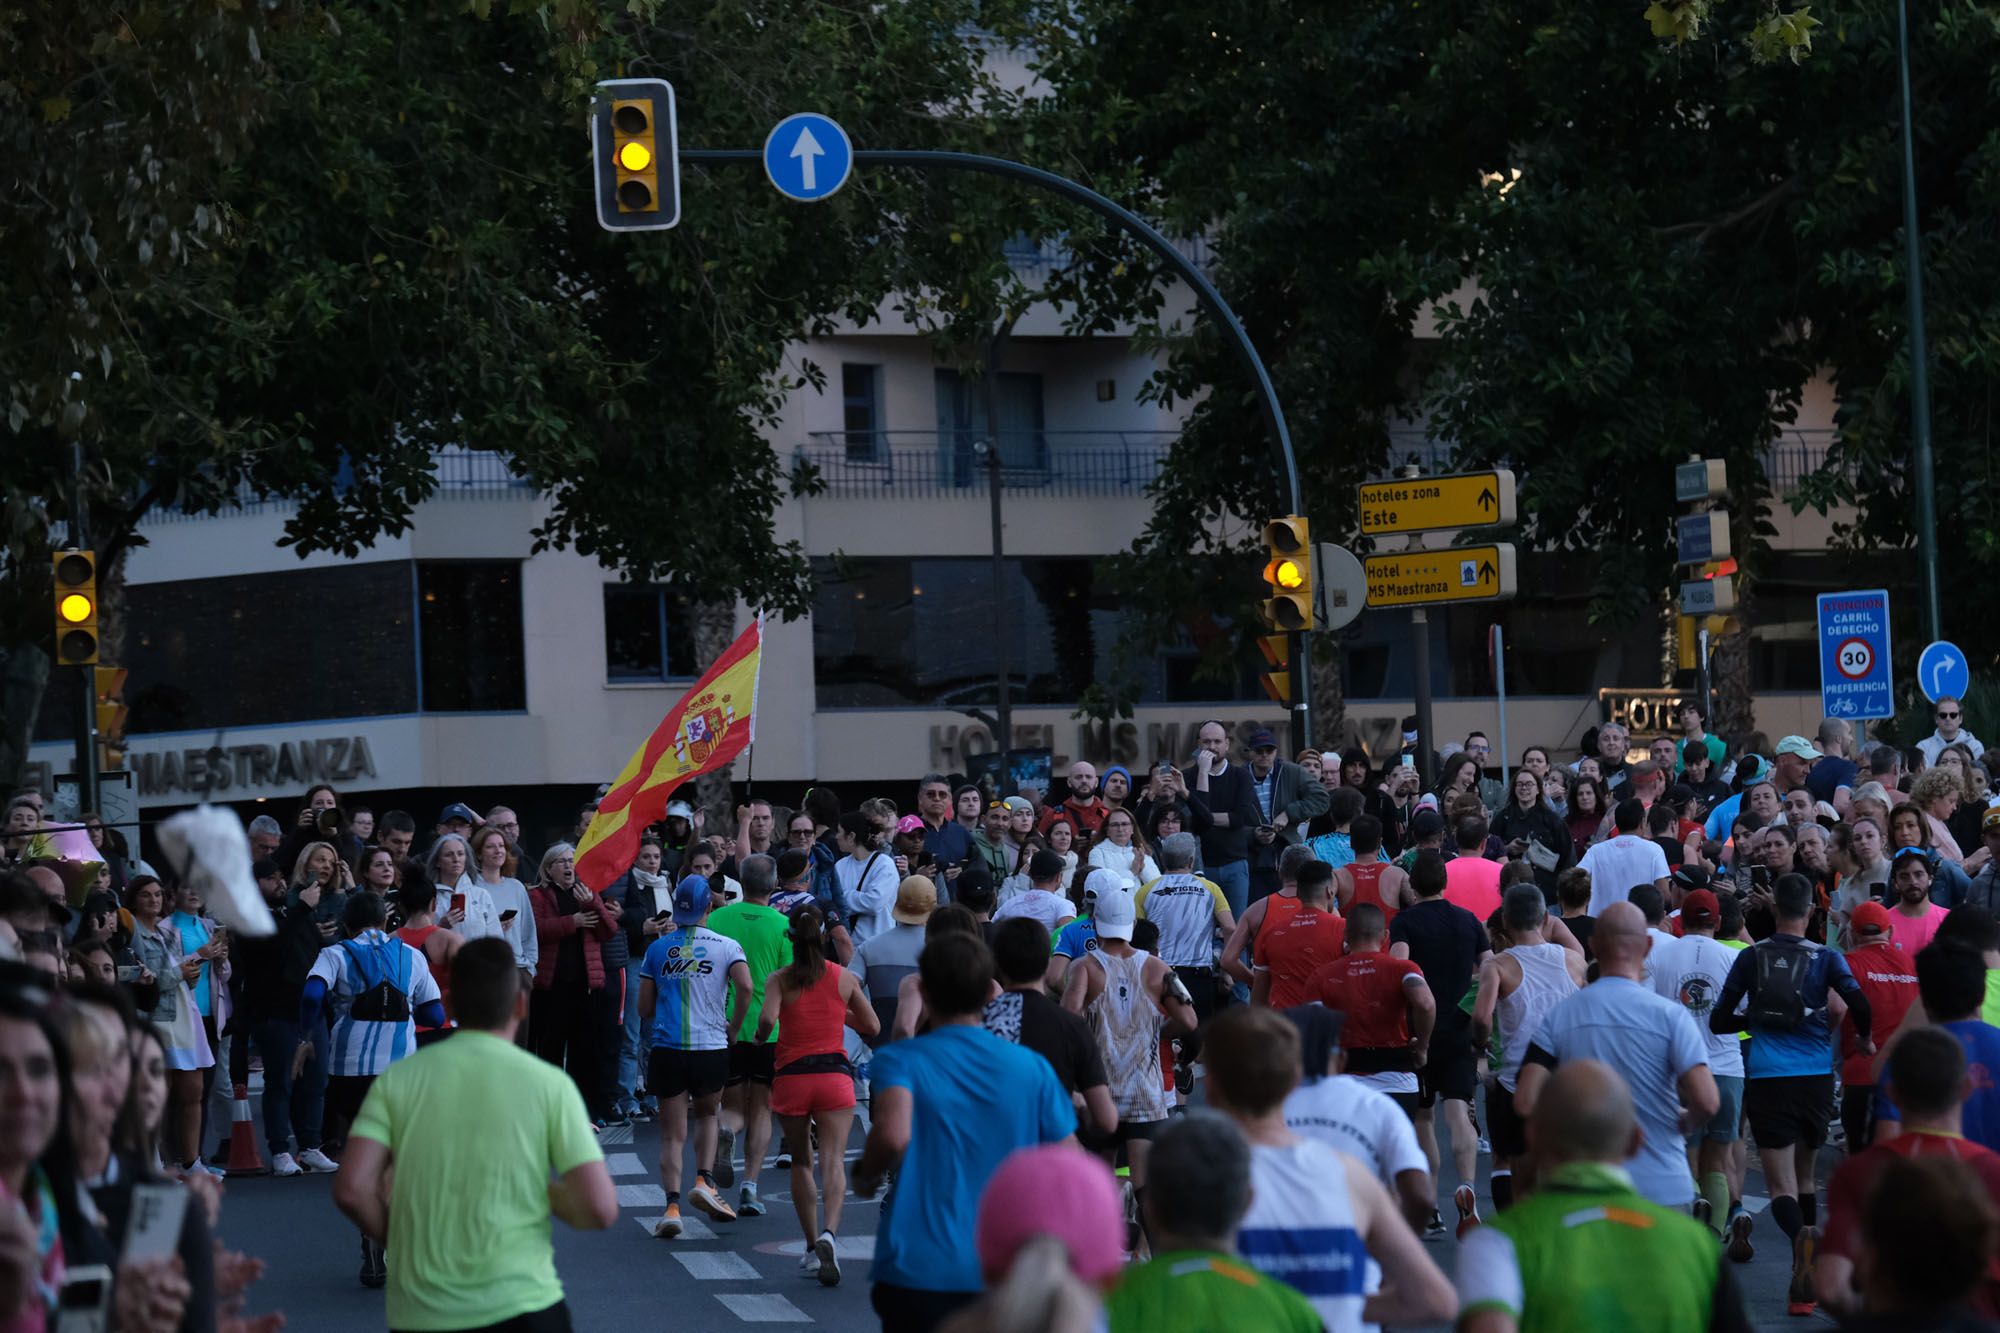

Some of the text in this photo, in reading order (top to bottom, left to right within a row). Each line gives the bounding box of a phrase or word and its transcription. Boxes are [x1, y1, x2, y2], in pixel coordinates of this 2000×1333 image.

[1362, 486, 1441, 503] hoteles zona
[1363, 510, 1398, 526] Este
[1367, 563, 1400, 579] Hotel
[1368, 581, 1449, 598] MS Maestranza
[1833, 611, 1873, 624] CARRIL
[1827, 622, 1880, 636] DERECHO
[1844, 651, 1866, 666] 30
[1826, 681, 1887, 695] PREFERENCIA
[1609, 696, 1683, 731] HOTE
[930, 722, 1070, 769] HOEL
